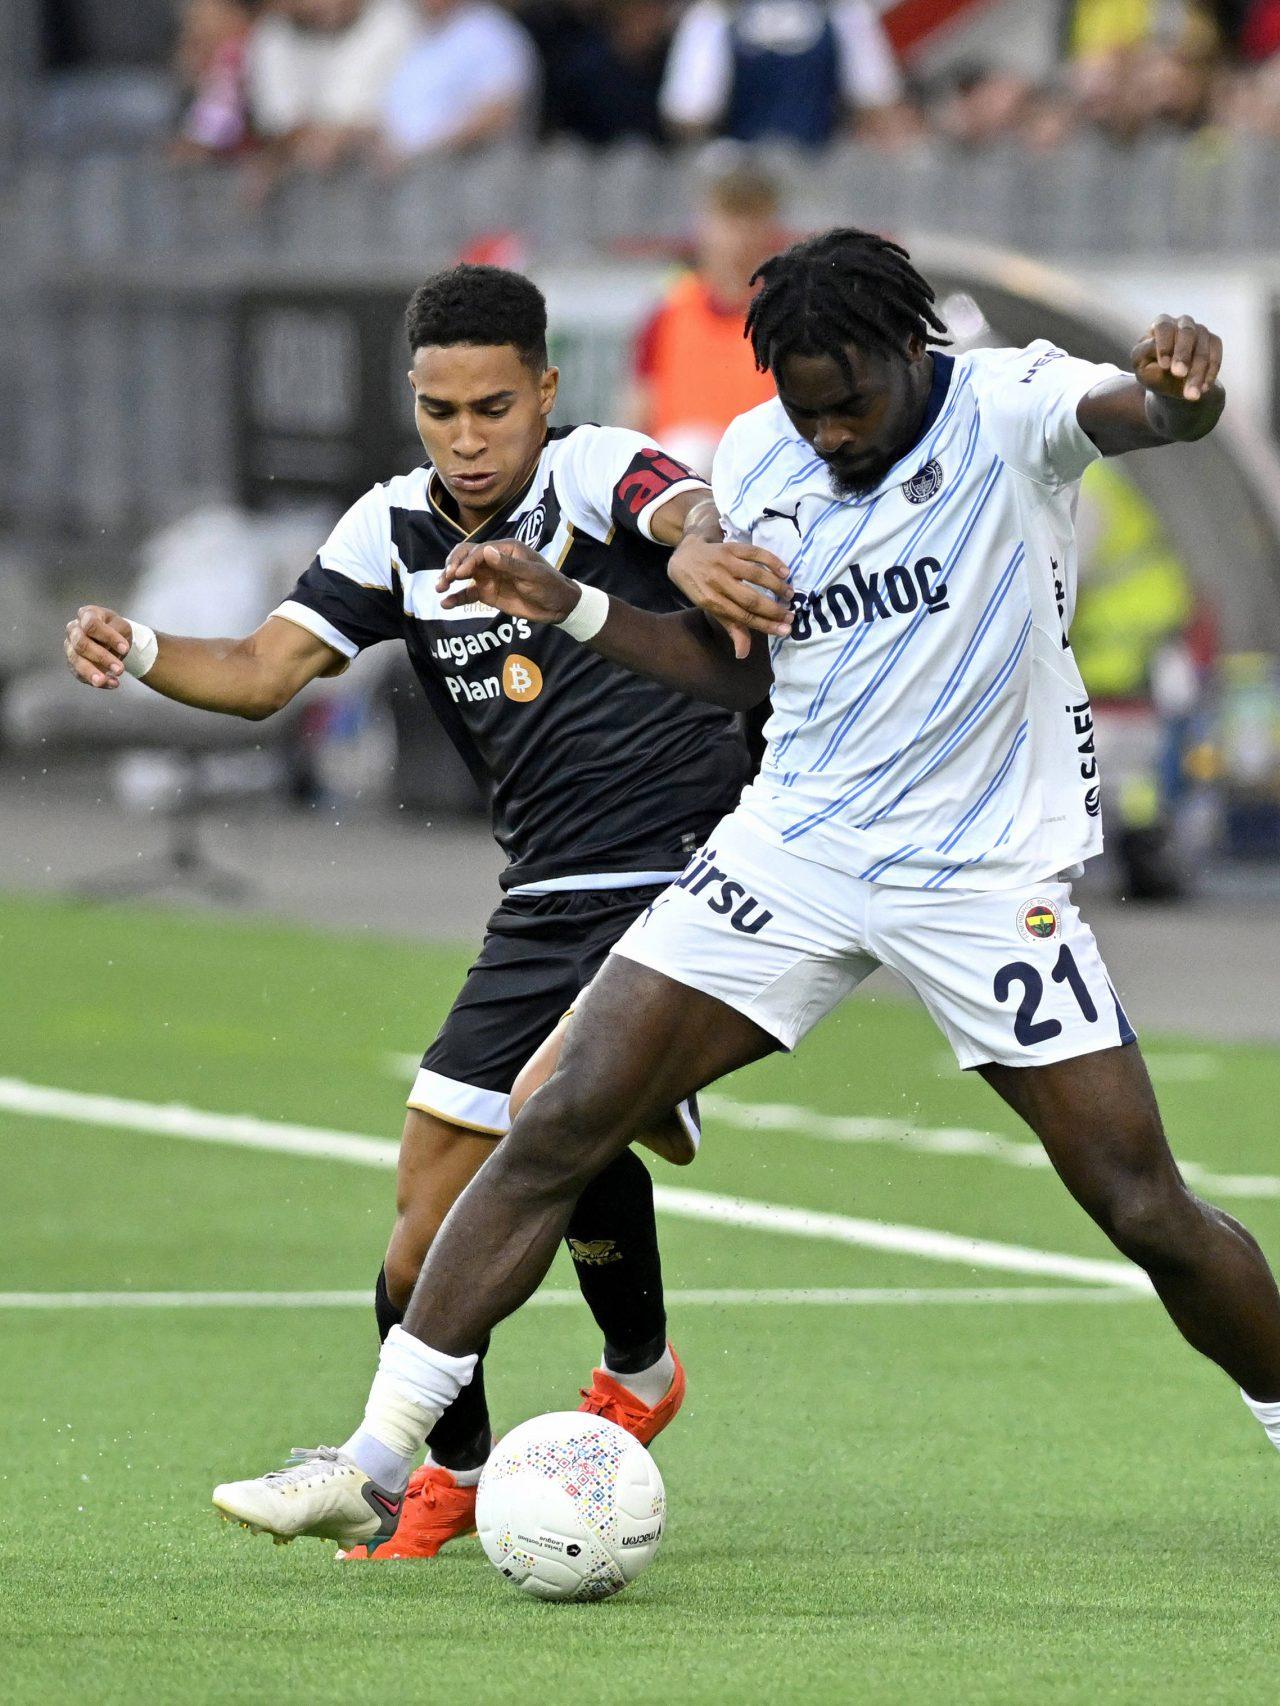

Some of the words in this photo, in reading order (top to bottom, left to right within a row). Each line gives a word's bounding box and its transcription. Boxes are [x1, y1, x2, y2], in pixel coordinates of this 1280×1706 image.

[430, 617, 532, 666] ugano's
[445, 675, 500, 703] Plan
[994, 943, 1098, 1047] 21
[539, 1536, 564, 1548] League
[544, 1543, 563, 1553] Swiss
[622, 1531, 656, 1546] macron
